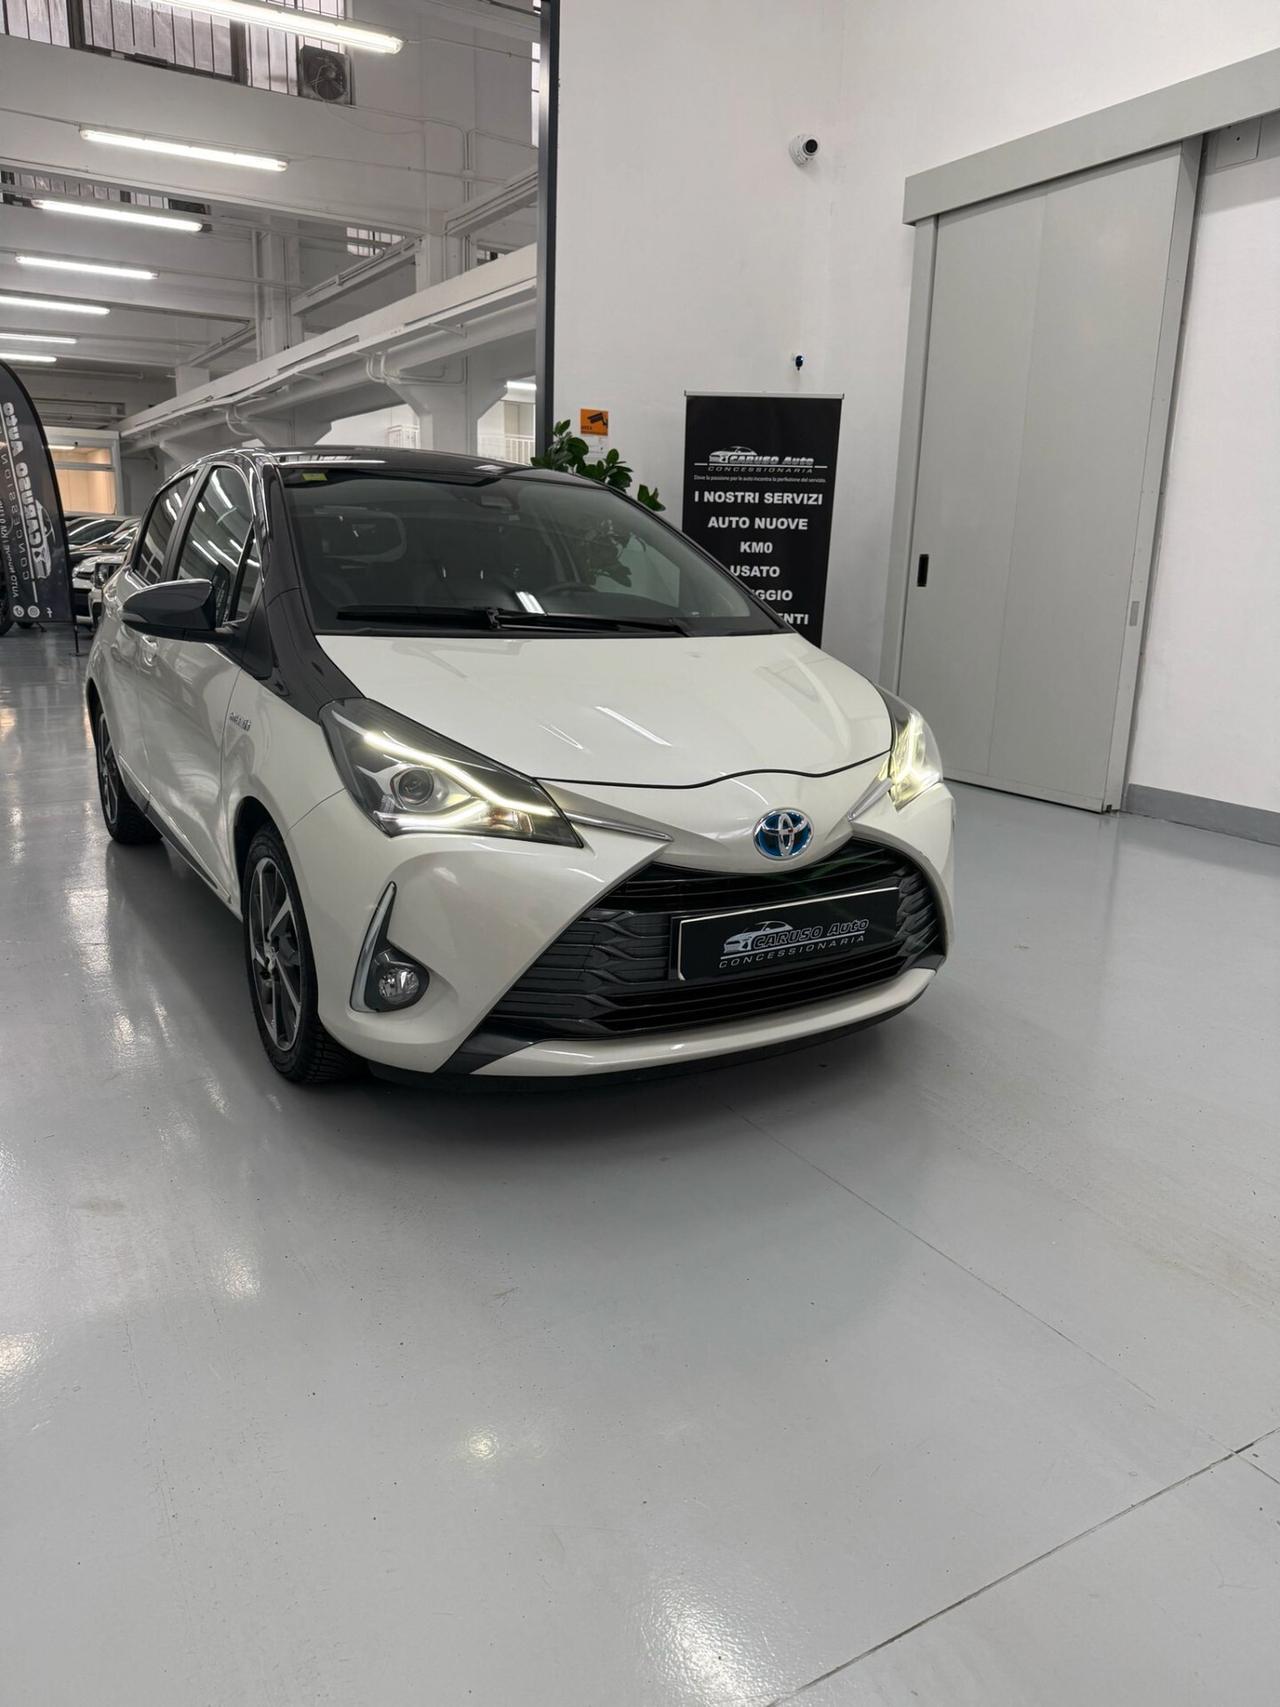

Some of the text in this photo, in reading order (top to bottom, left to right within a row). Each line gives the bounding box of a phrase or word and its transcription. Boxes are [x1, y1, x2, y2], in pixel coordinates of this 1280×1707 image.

[694, 491, 823, 505] I NOSTRI SERVIZI
[708, 516, 808, 530] AUTO NUOVE
[730, 565, 780, 577] USATO
[753, 589, 793, 601] GGIO
[753, 926, 823, 950] CARUSO
[719, 934, 865, 969] CONCESSIONARIA
